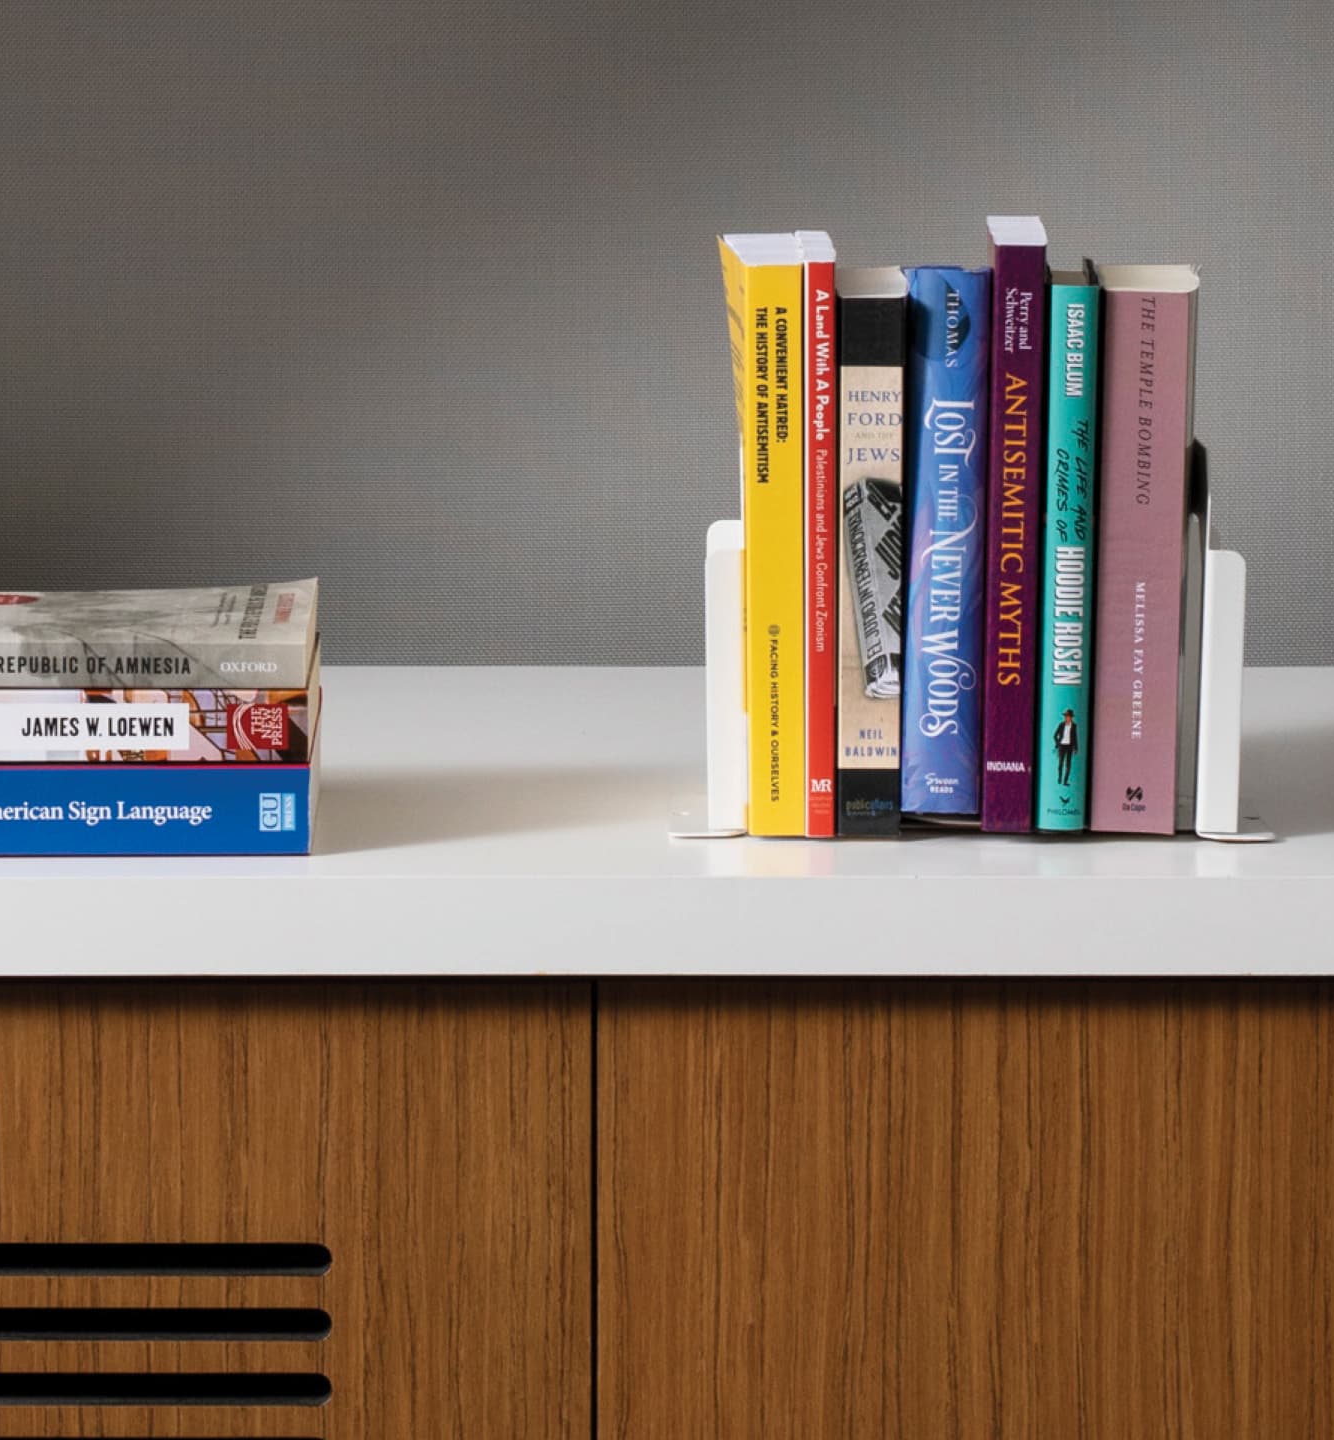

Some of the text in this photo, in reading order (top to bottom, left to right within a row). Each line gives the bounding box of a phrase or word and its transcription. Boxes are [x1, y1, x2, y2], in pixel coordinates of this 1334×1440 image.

[945, 289, 960, 368] THOMAS
[1005, 288, 1018, 354] Schweitzer
[1019, 291, 1033, 350] Perry and
[775, 307, 789, 443] A CONVENIENT HATRED:
[813, 289, 830, 441] A Land With A People
[1065, 303, 1085, 398] ISAAC BLUM
[756, 307, 769, 483] THE HISTORY OF ANTISEMITISM
[848, 391, 901, 402] HENRY
[848, 413, 903, 426] FORD
[1135, 296, 1156, 506] THE TEMPLE BOMBING
[847, 448, 900, 464] JEWS
[1071, 418, 1090, 542] THE LIFE AND
[1055, 448, 1070, 543] CRIMES OF
[816, 449, 828, 652] Palestinians and Jews Confront Zionism
[997, 372, 1028, 686] ANTISEMITIC MYTHS
[919, 397, 978, 738] LOST IN THE NEVER WOODS
[1052, 546, 1085, 686] HOODIE ROSEN
[86, 656, 106, 674] OF
[114, 657, 191, 675] AMNESIA
[220, 661, 277, 673] OXFORD
[1131, 581, 1146, 739] MELISSA FAY GREENE
[21, 717, 174, 737] JAMES W. LOEWEN
[251, 707, 261, 734] THE
[261, 707, 271, 739] NEW
[271, 707, 283, 745] PRESS
[770, 639, 779, 802] FACING HISTORY & OURSELVES
[859, 729, 883, 739] NEIL
[844, 746, 898, 757] BALDWIN
[987, 761, 1025, 772] INDIANA
[68, 800, 112, 826] Sign
[117, 800, 212, 826] Language
[262, 796, 279, 829] GU
[811, 779, 832, 792] MR
